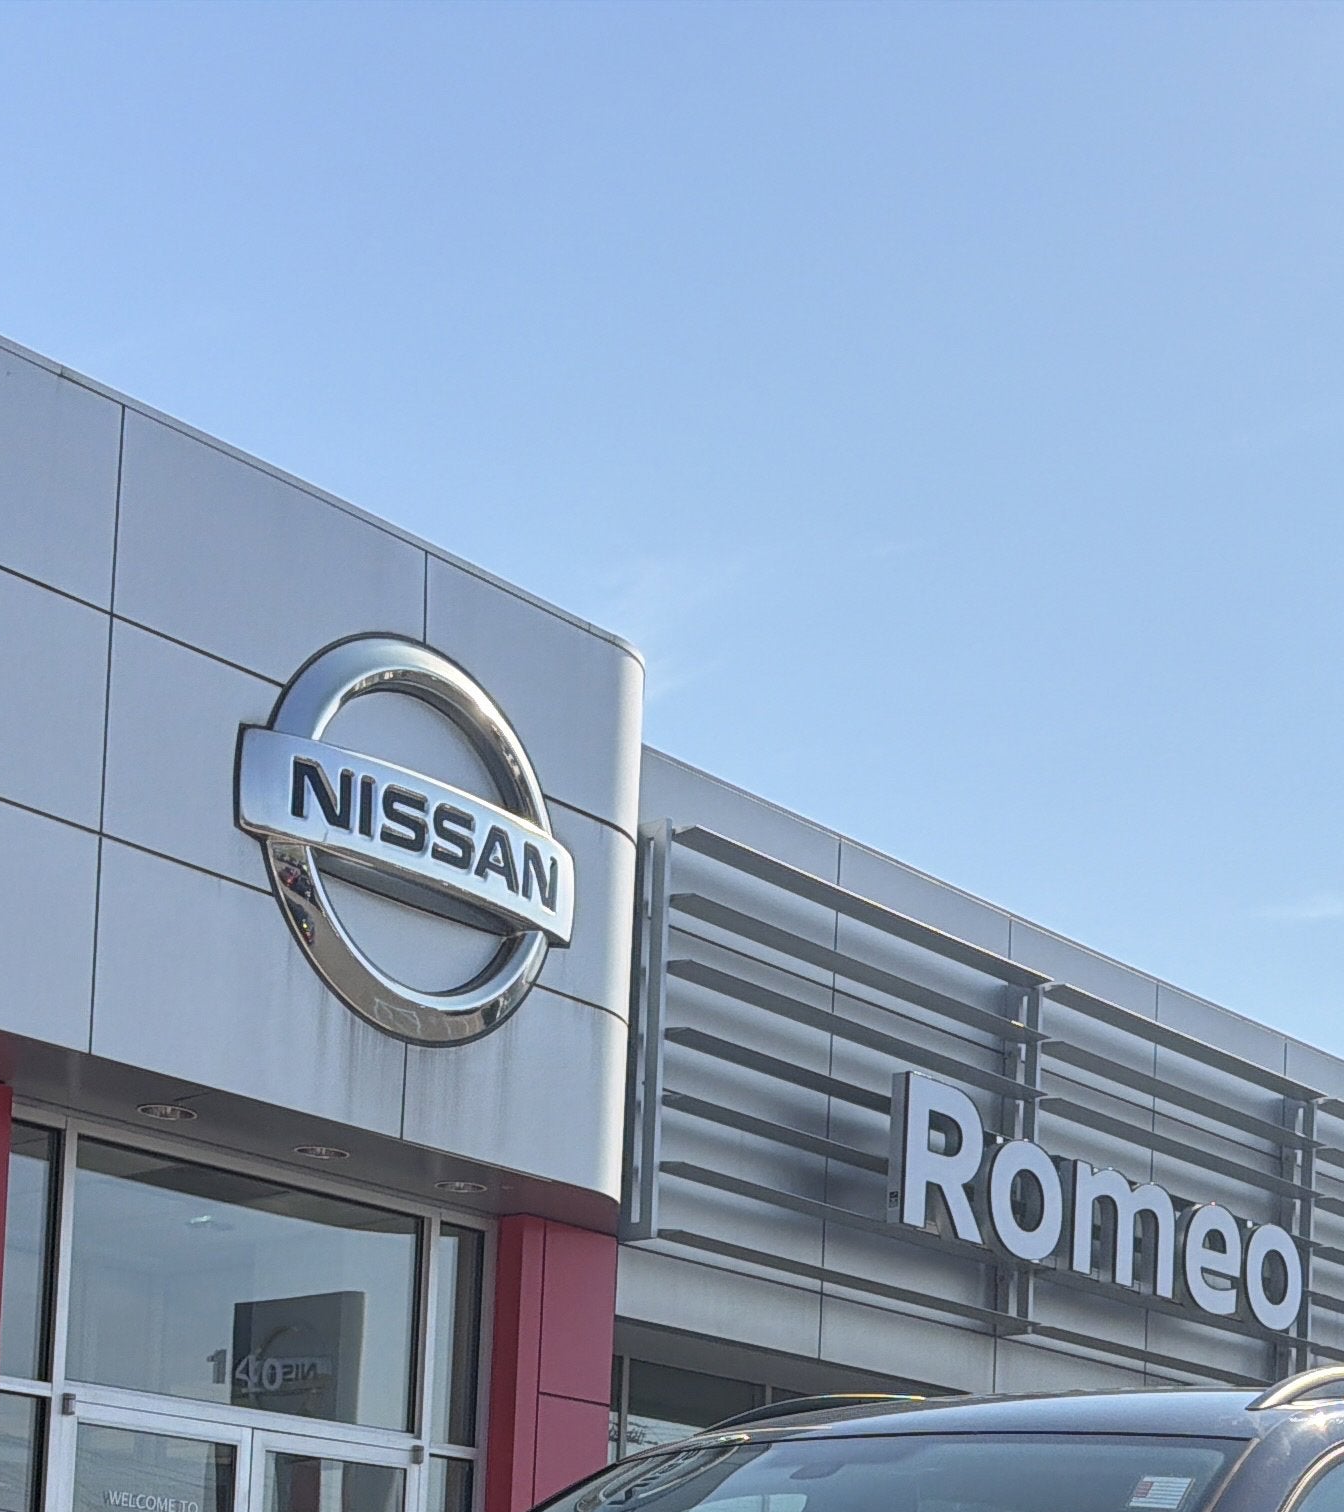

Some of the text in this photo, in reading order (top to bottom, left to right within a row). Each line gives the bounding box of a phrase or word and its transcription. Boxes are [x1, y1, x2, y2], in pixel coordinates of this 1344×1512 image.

[290, 755, 558, 914] NISSAN
[896, 1071, 1304, 1331] Romeo
[207, 1348, 282, 1392] 140
